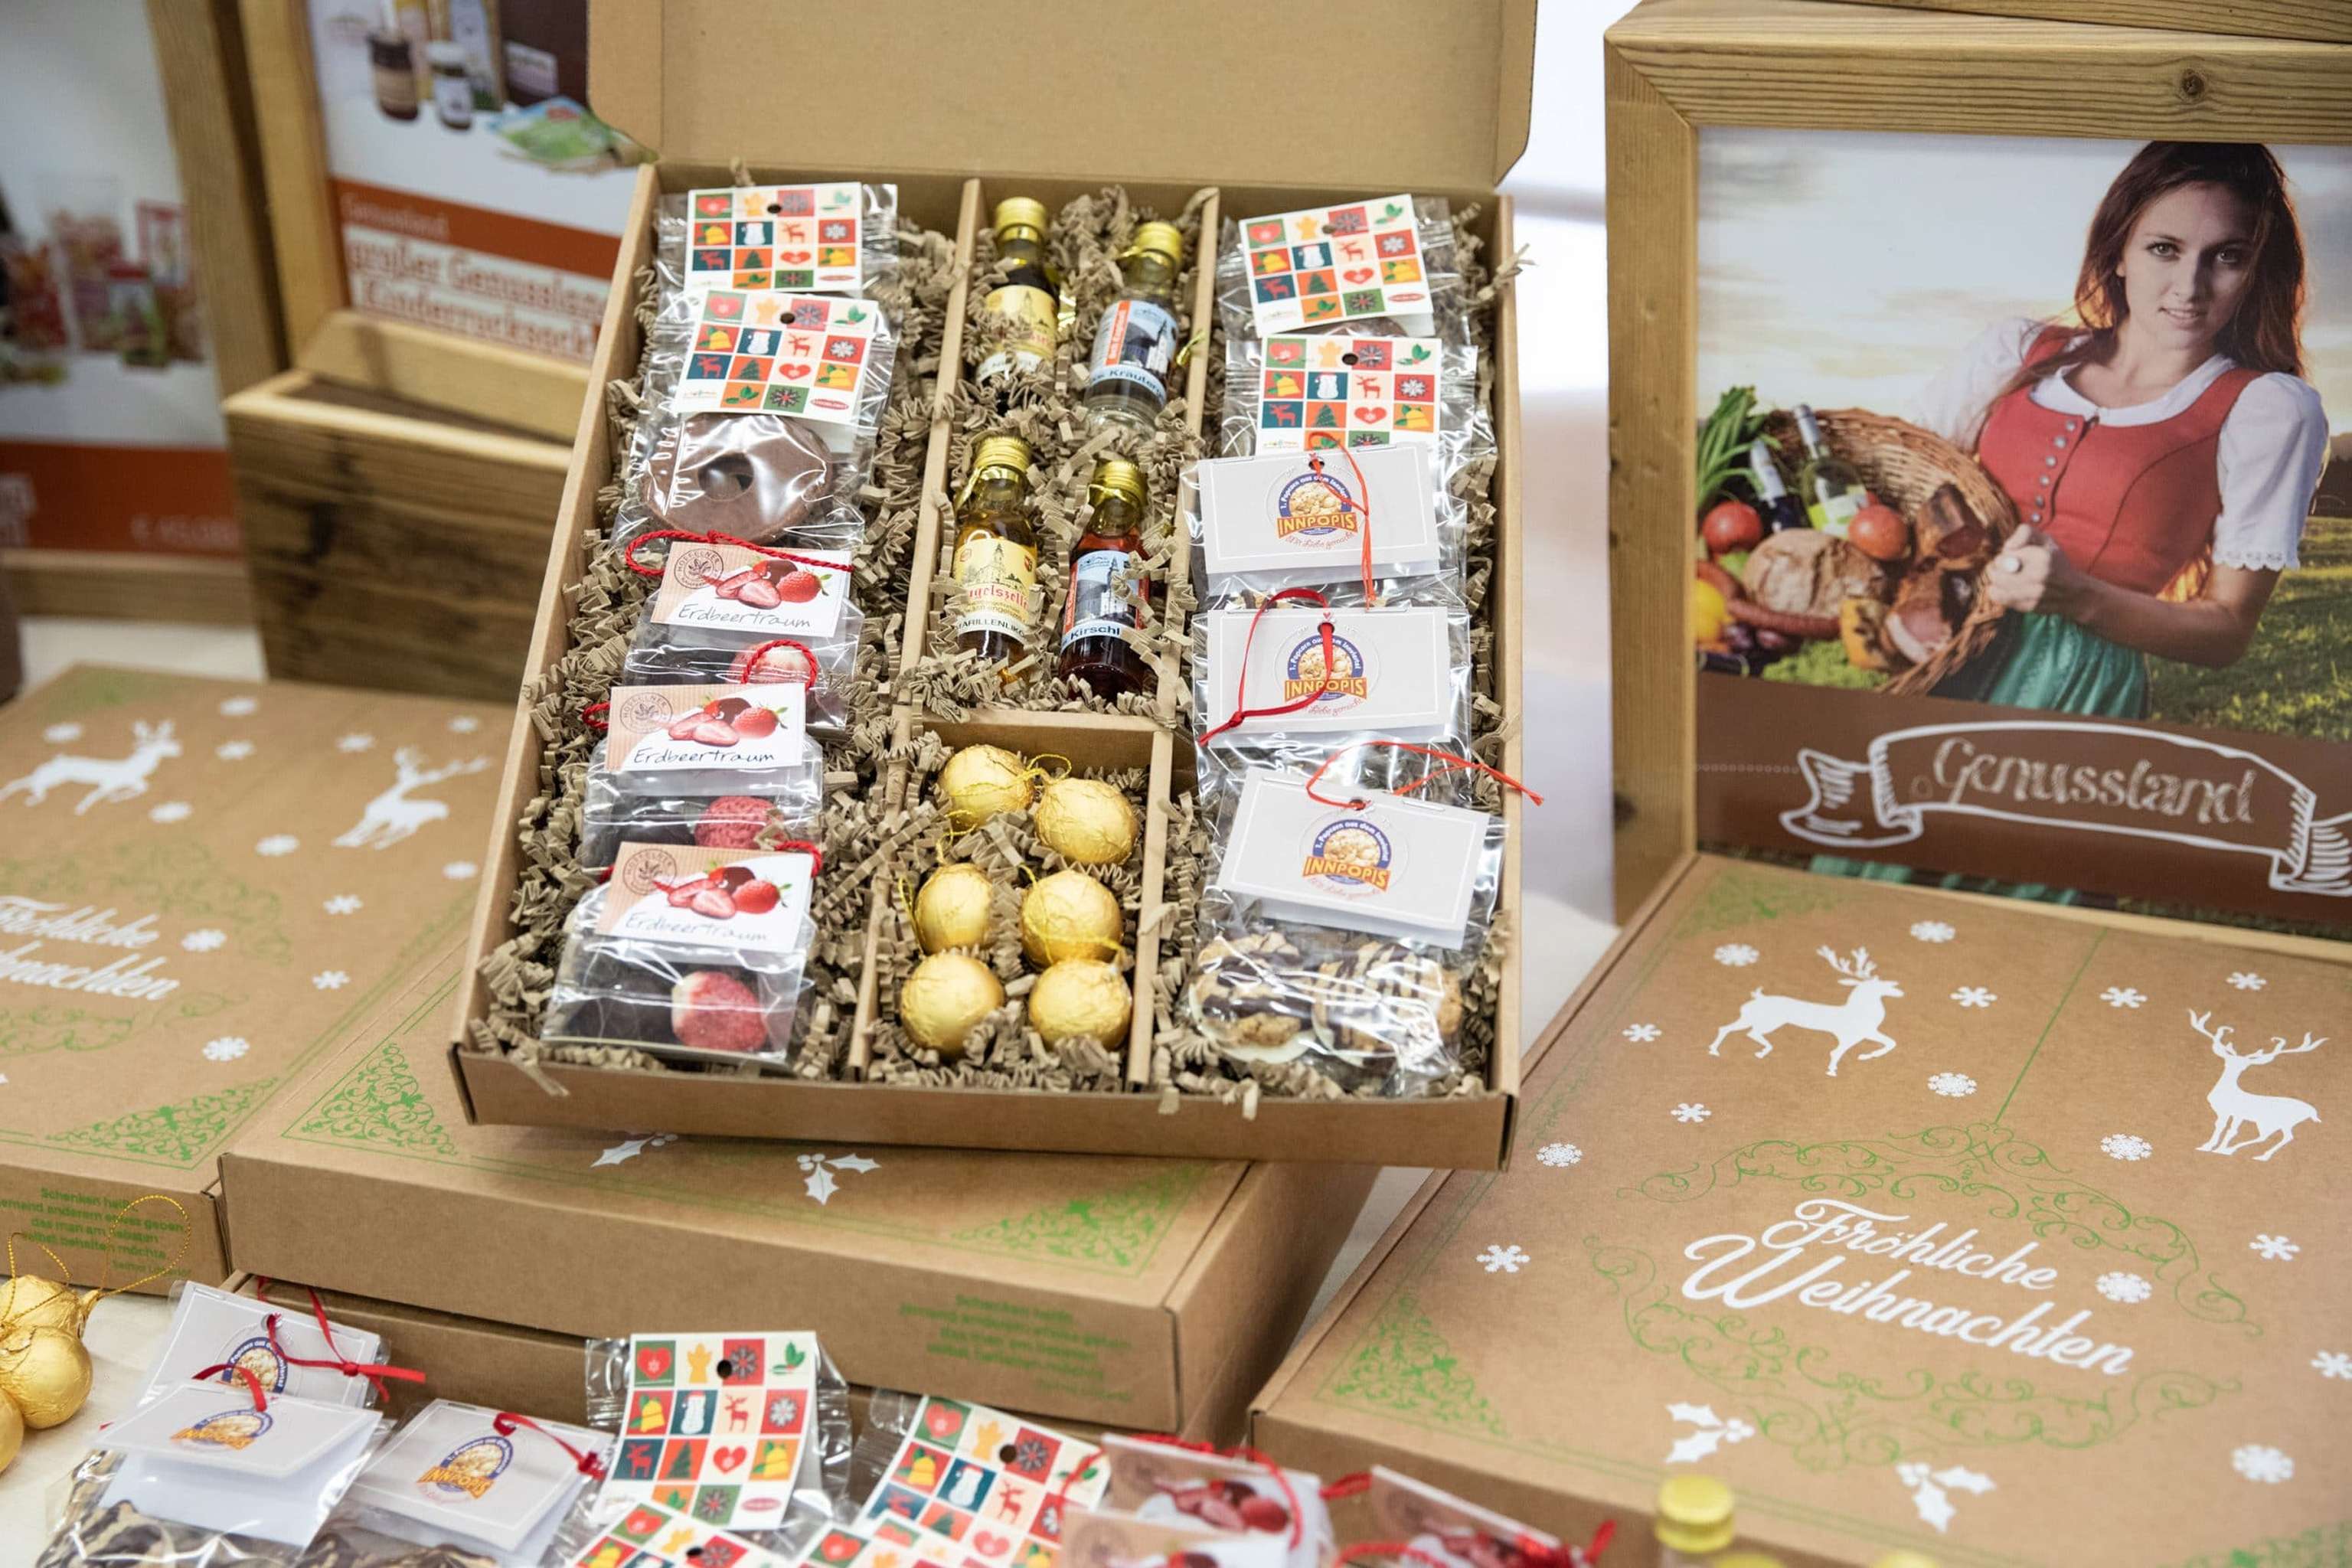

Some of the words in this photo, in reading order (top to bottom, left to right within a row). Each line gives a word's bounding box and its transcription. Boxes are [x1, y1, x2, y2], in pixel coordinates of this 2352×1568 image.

[1278, 513, 1356, 536] INNPOPIS
[678, 603, 811, 628] Erdbeertraum
[1070, 626, 1120, 639] Kirschl
[1286, 678, 1365, 700] INNPOPIS
[633, 746, 775, 764] Erdbeertraum
[1932, 737, 2256, 824] Genussland
[1305, 857, 1387, 887] INNPOPIS
[1761, 1198, 2058, 1290] Fröhliche
[1681, 1233, 2135, 1375] Weihnachten
